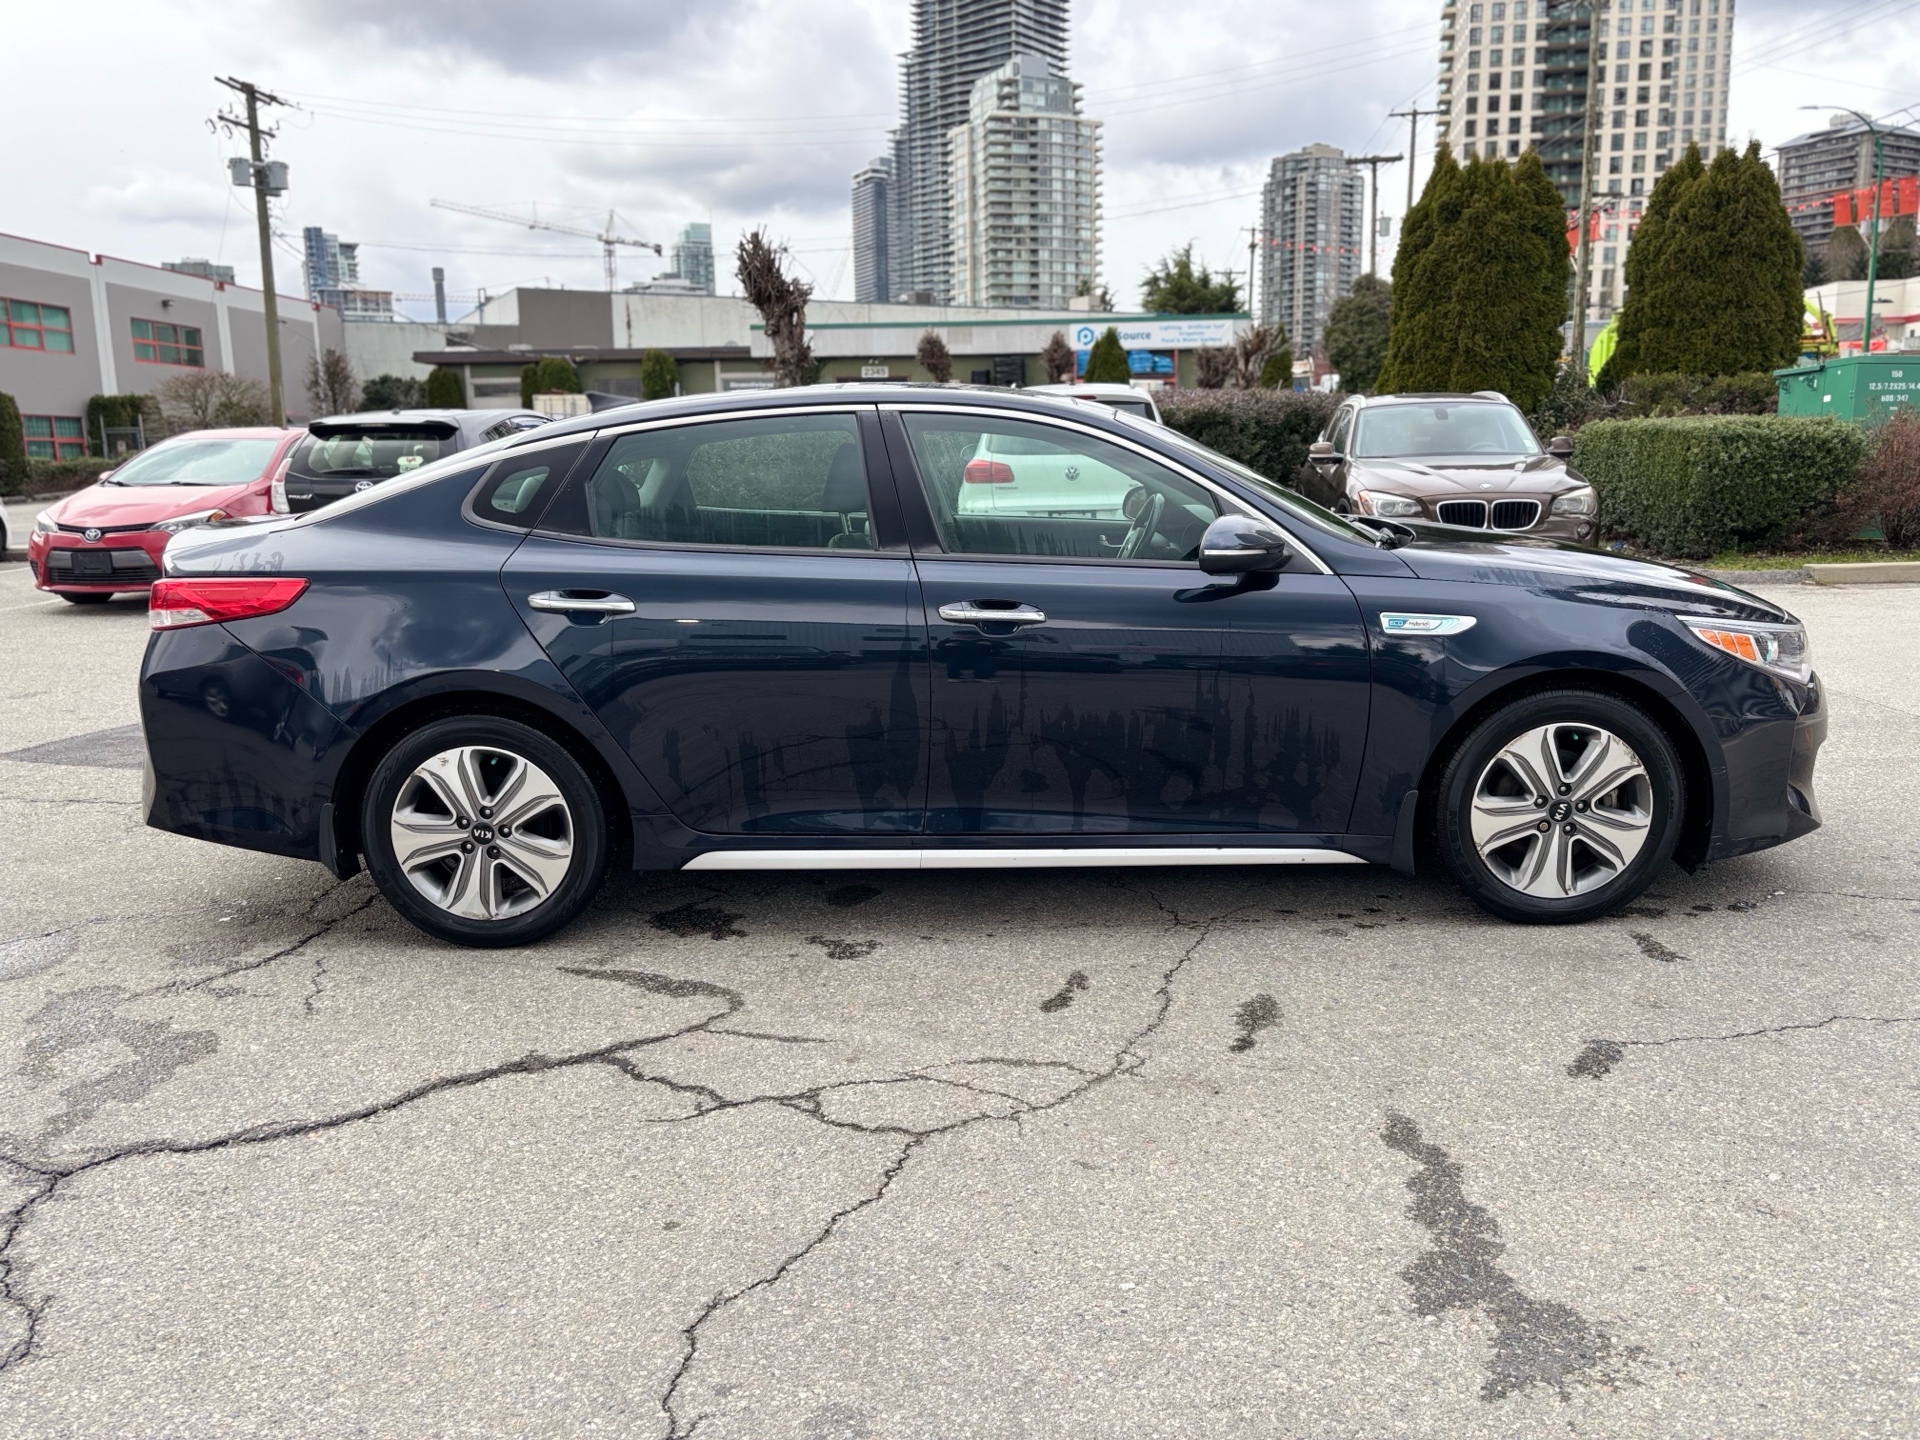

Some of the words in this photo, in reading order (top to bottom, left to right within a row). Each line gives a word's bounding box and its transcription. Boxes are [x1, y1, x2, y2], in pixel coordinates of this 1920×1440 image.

[863, 367, 886, 376] 2345
[1891, 370, 1903, 378] 150
[1553, 803, 1568, 821] KIA
[473, 829, 492, 839] KIA
